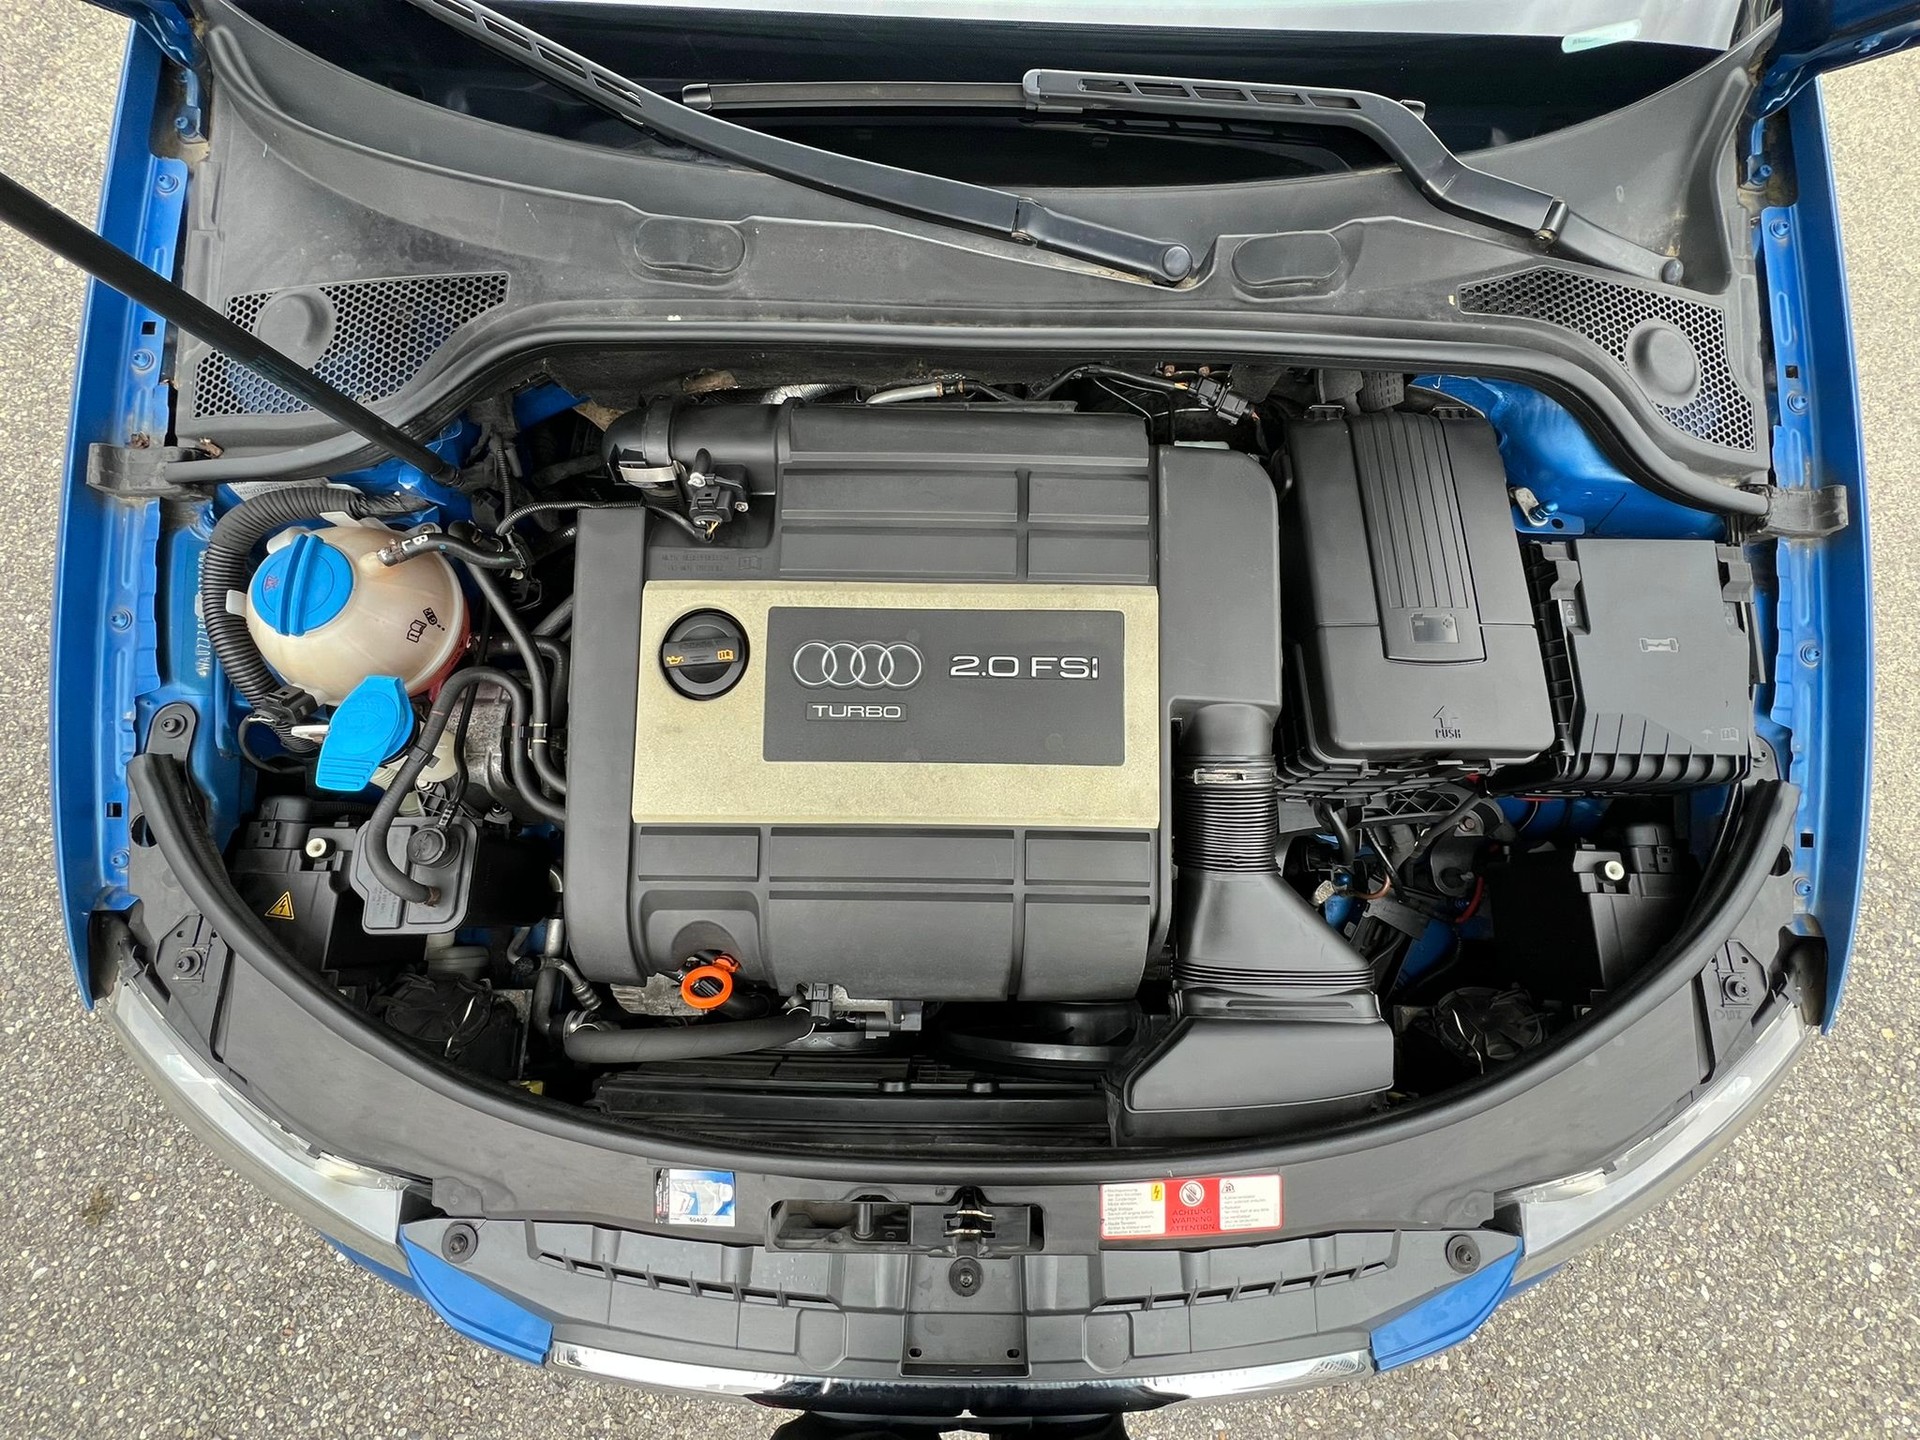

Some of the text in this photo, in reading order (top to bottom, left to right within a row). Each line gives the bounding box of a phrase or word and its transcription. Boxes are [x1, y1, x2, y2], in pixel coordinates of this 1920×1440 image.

[950, 655, 1019, 678] 2.0
[812, 705, 901, 718] TURBO
[1435, 729, 1461, 739] PUSH
[1172, 1208, 1212, 1216] ACHTUNG
[1172, 1216, 1212, 1224] WARNING
[1169, 1224, 1215, 1232] ATTENTION
